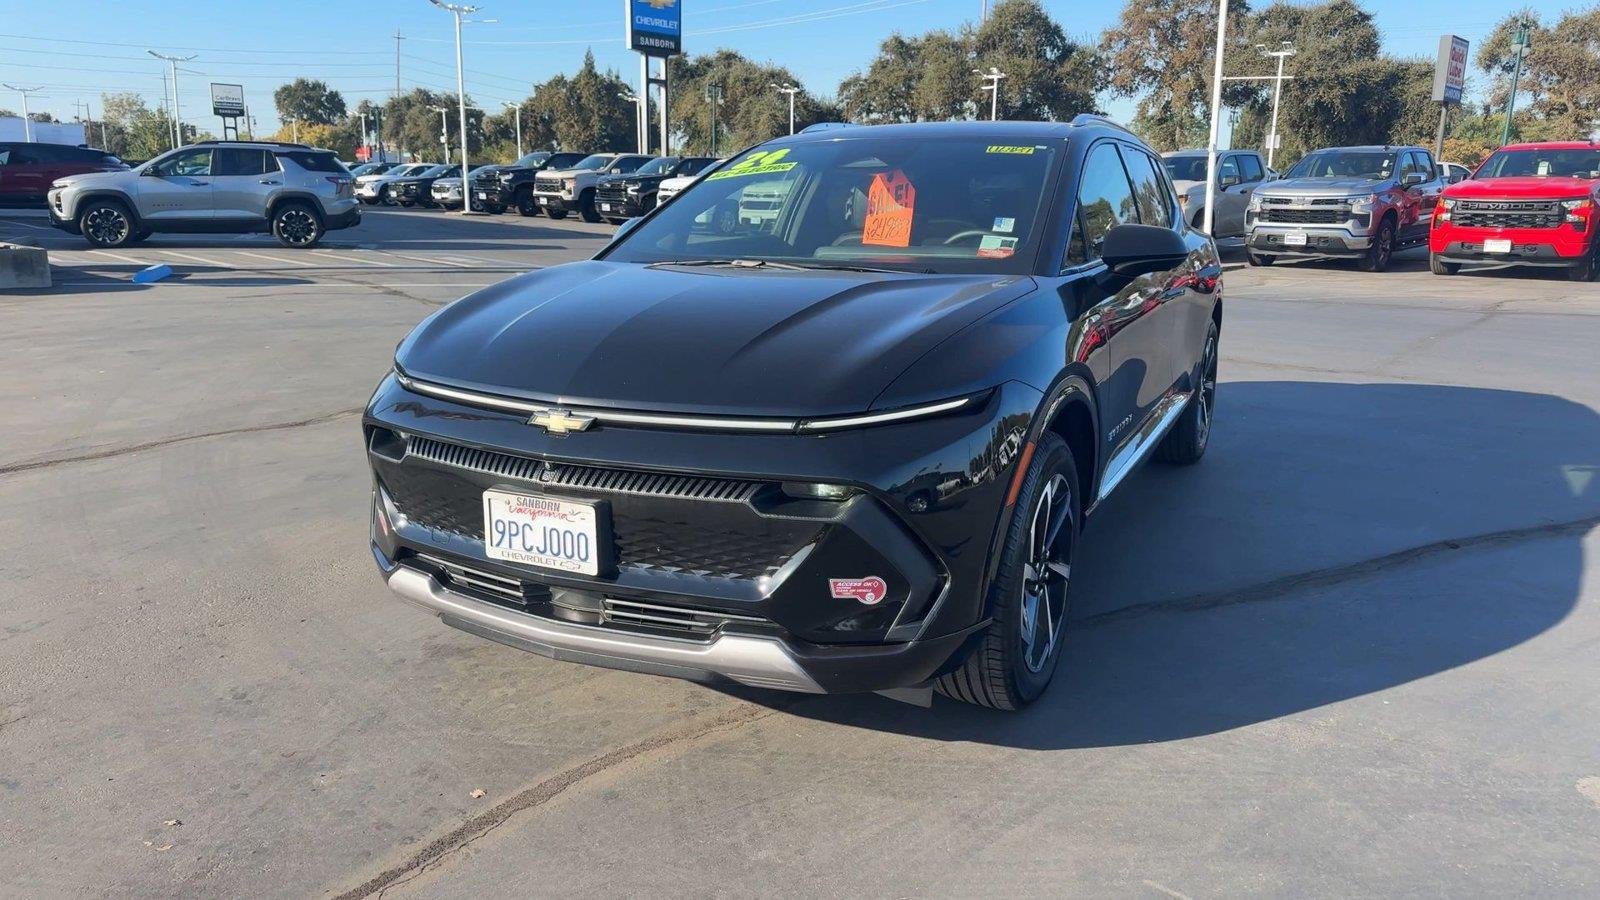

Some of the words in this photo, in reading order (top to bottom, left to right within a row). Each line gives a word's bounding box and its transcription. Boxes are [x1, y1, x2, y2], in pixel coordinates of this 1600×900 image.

[635, 15, 678, 29] CHEVROLET
[640, 36, 675, 49] SANBORN
[516, 497, 560, 512] SANBORN
[494, 518, 589, 562] 9PCJ000
[502, 550, 556, 565] CHEVROLET
